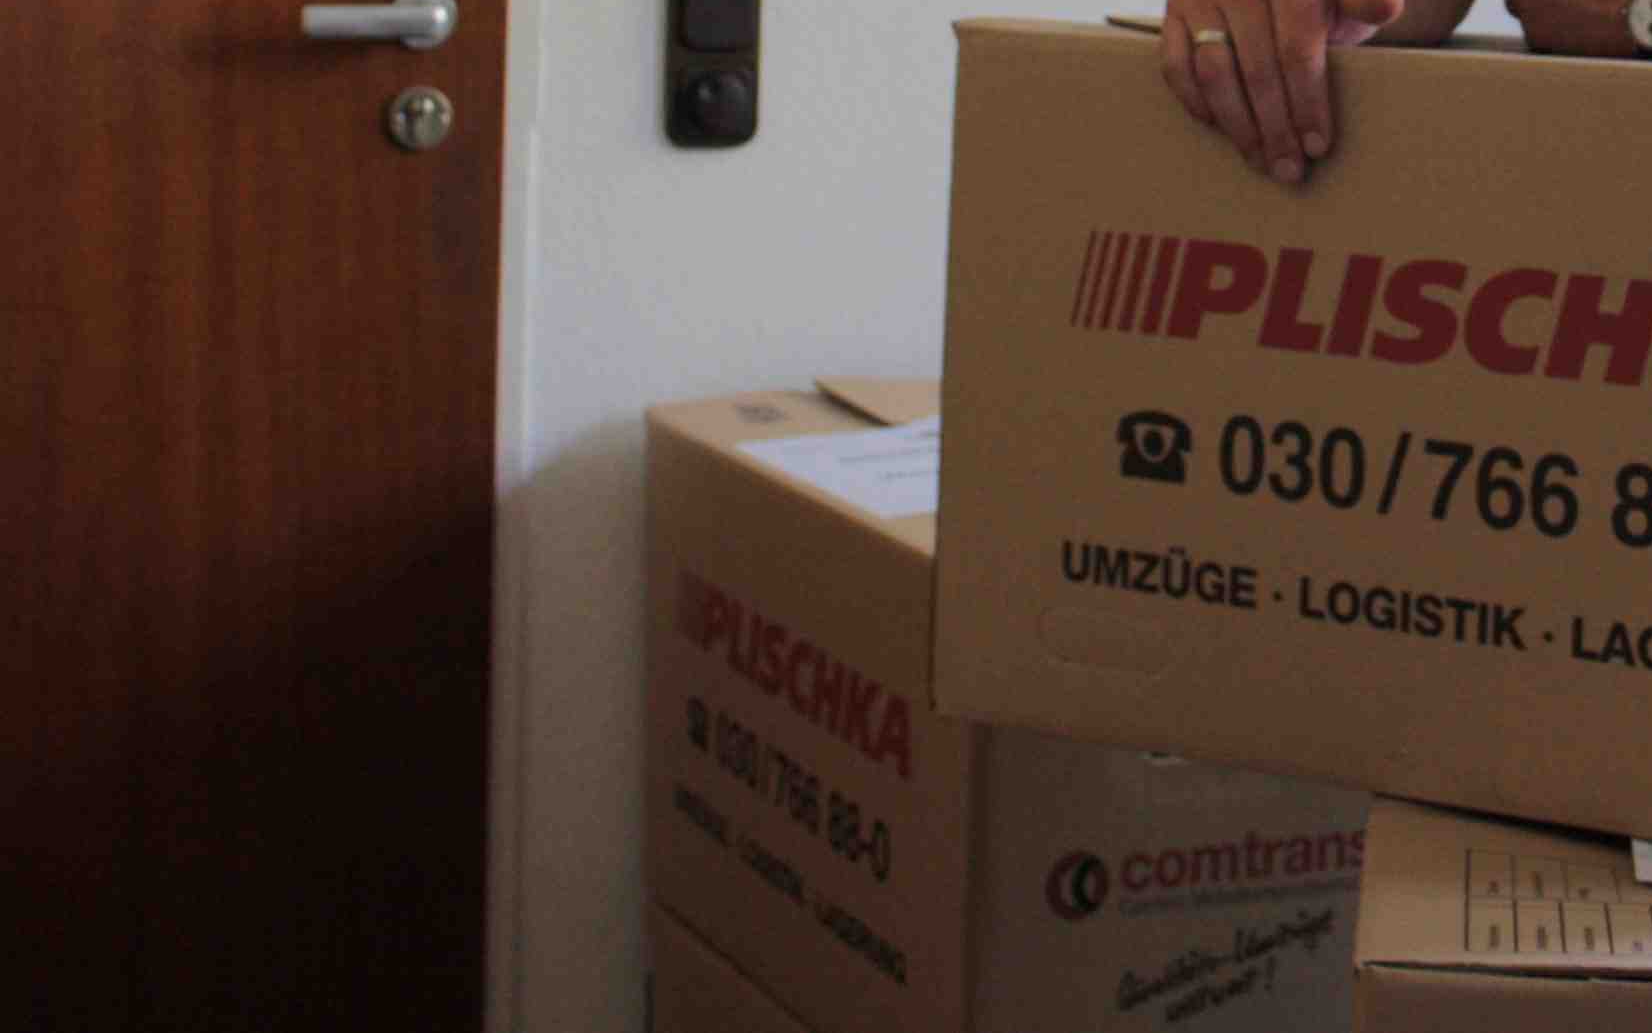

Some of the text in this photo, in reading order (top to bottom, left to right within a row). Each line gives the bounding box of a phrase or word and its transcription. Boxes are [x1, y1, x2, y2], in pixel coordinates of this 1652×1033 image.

[1062, 541, 1259, 610] UMZÜGE
[1299, 576, 1527, 652] LOGISTIK
[700, 581, 913, 780] PLISCHKA
[1120, 828, 1365, 892] comtrans
